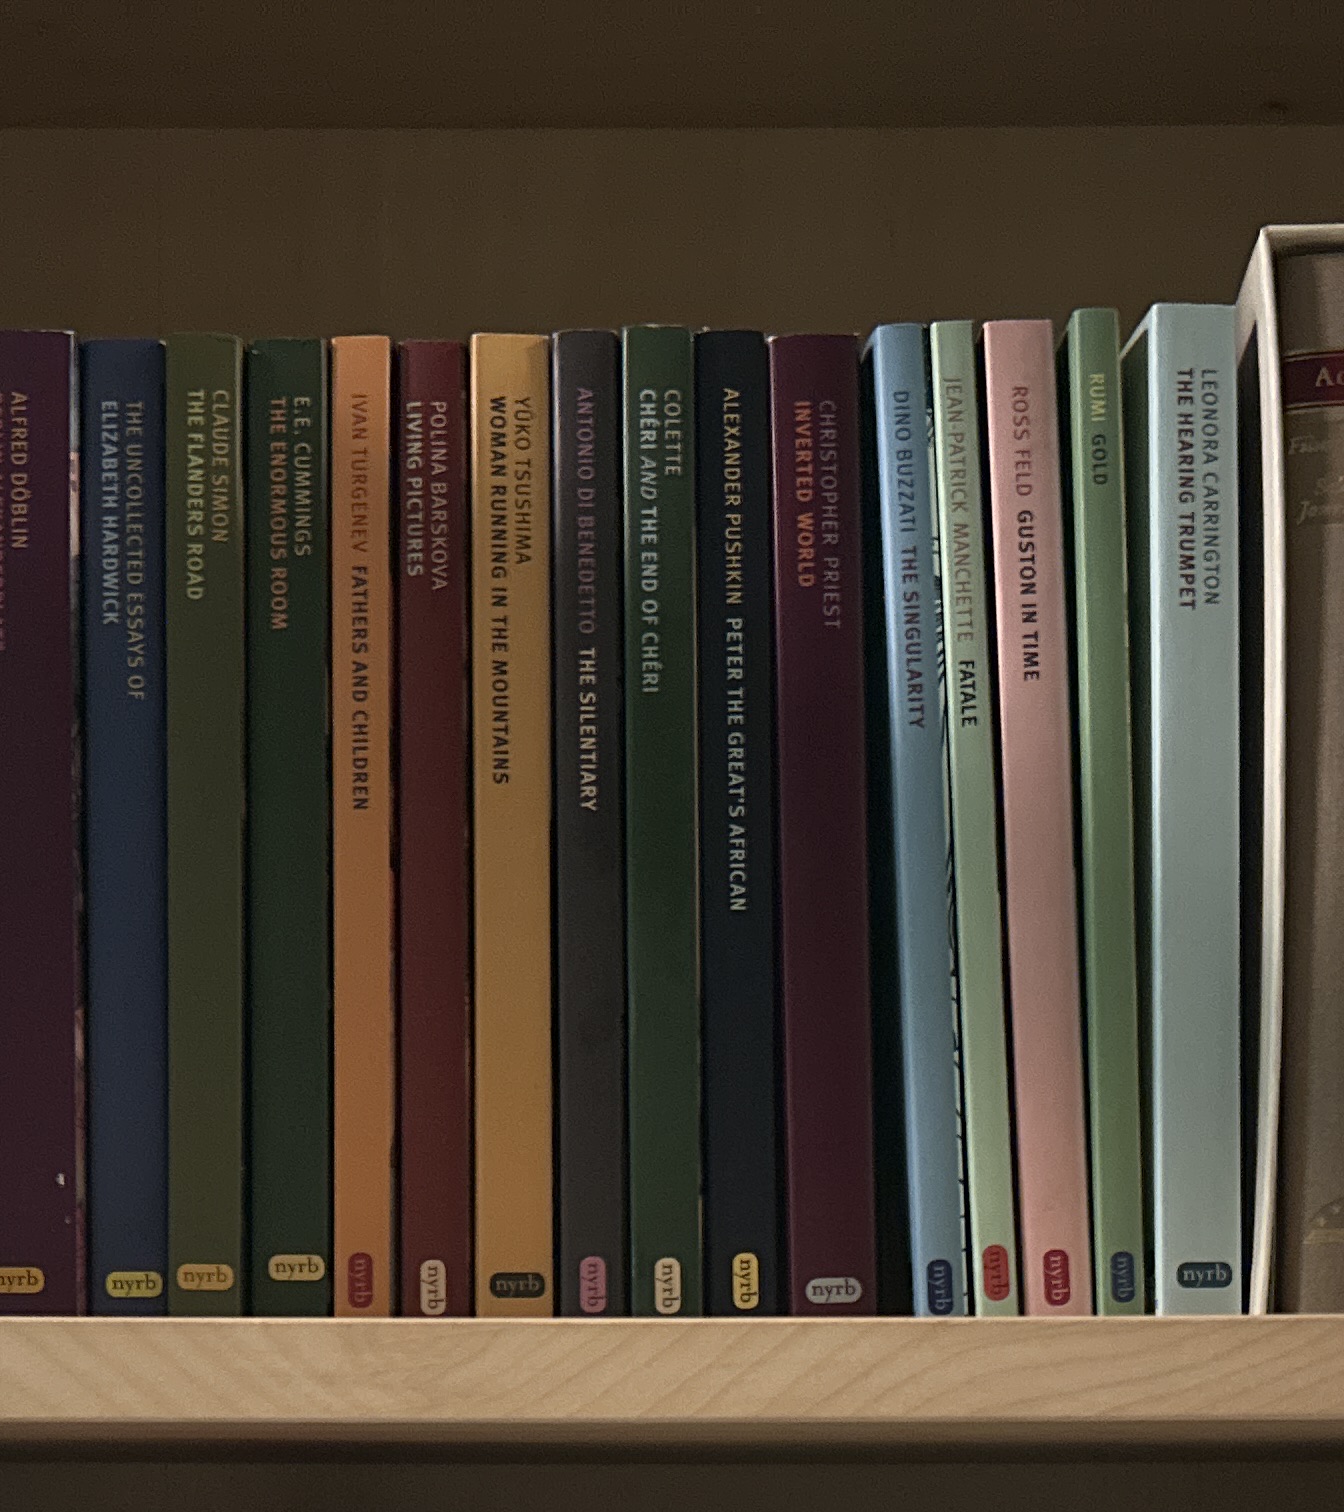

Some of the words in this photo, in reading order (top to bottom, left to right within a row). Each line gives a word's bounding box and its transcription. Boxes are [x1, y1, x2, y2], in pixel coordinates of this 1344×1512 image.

[268, 396, 287, 434] THE
[292, 396, 311, 431] E.E.
[350, 394, 369, 440] IVAN
[1012, 387, 1033, 443] ROSS
[1088, 374, 1107, 421] RUMI
[1175, 368, 1195, 407] THE
[1200, 369, 1219, 465] LEONORA
[9, 391, 30, 466] ALFRED
[405, 401, 424, 470] LIVING
[429, 401, 448, 474] POLINA
[638, 389, 662, 450] CHÉRI
[662, 390, 681, 475] COLETTE
[721, 388, 744, 507] ALEXANDER
[638, 456, 662, 499] AND
[1012, 449, 1033, 497] FELD
[1088, 433, 1107, 486] GOLD
[1175, 413, 1195, 505] HEARING
[9, 470, 30, 549] DÖBLIN
[268, 441, 287, 561] ENORMOUS
[292, 442, 311, 557] CUMMINGS
[350, 447, 369, 553] TURGENEV
[405, 477, 424, 576] PICTURES
[638, 506, 662, 546] THE
[429, 482, 448, 590] BARSKOVA
[721, 514, 744, 604] PUSHKIN
[1015, 510, 1041, 596] GUSTON
[1175, 511, 1195, 610] TRUMPET
[1200, 471, 1219, 606] CARRINGTON
[268, 569, 287, 630] ROOM
[638, 553, 662, 590] END
[351, 565, 370, 653] FATHERS
[638, 598, 662, 627] OF
[1015, 604, 1041, 623] IN
[638, 633, 662, 694] CHÉRI
[724, 618, 746, 681] PETER
[1015, 630, 1041, 681] TIME
[351, 660, 370, 703] AND
[724, 688, 746, 727] THE
[351, 710, 370, 810] CHILDREN
[724, 732, 746, 818] GREAT'S
[724, 825, 746, 911] AFRICAN
[273, 1261, 319, 1275] nyrb
[422, 1266, 442, 1310] nyrb
[656, 1265, 677, 1307] nyrb
[734, 1259, 754, 1303] nyrb
[1046, 1256, 1066, 1300] nyrb
